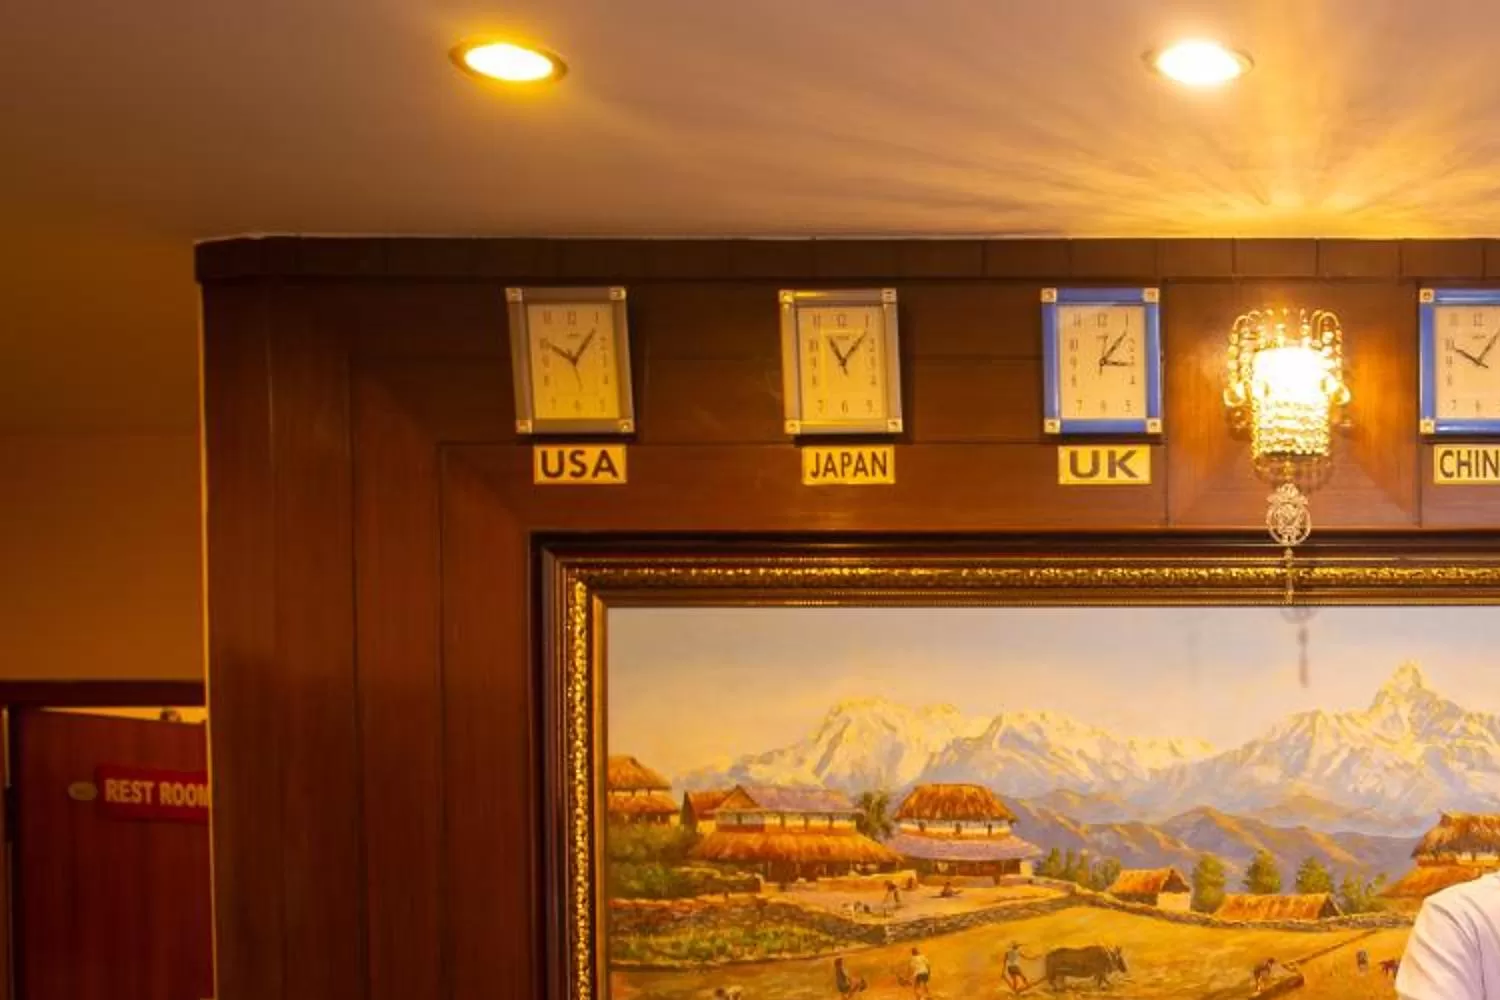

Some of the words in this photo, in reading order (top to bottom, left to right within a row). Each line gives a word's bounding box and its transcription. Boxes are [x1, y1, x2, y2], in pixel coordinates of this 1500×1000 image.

[541, 450, 618, 478] USA
[810, 450, 888, 478] JAPAN
[1069, 450, 1140, 478] UK
[104, 778, 154, 805] REST
